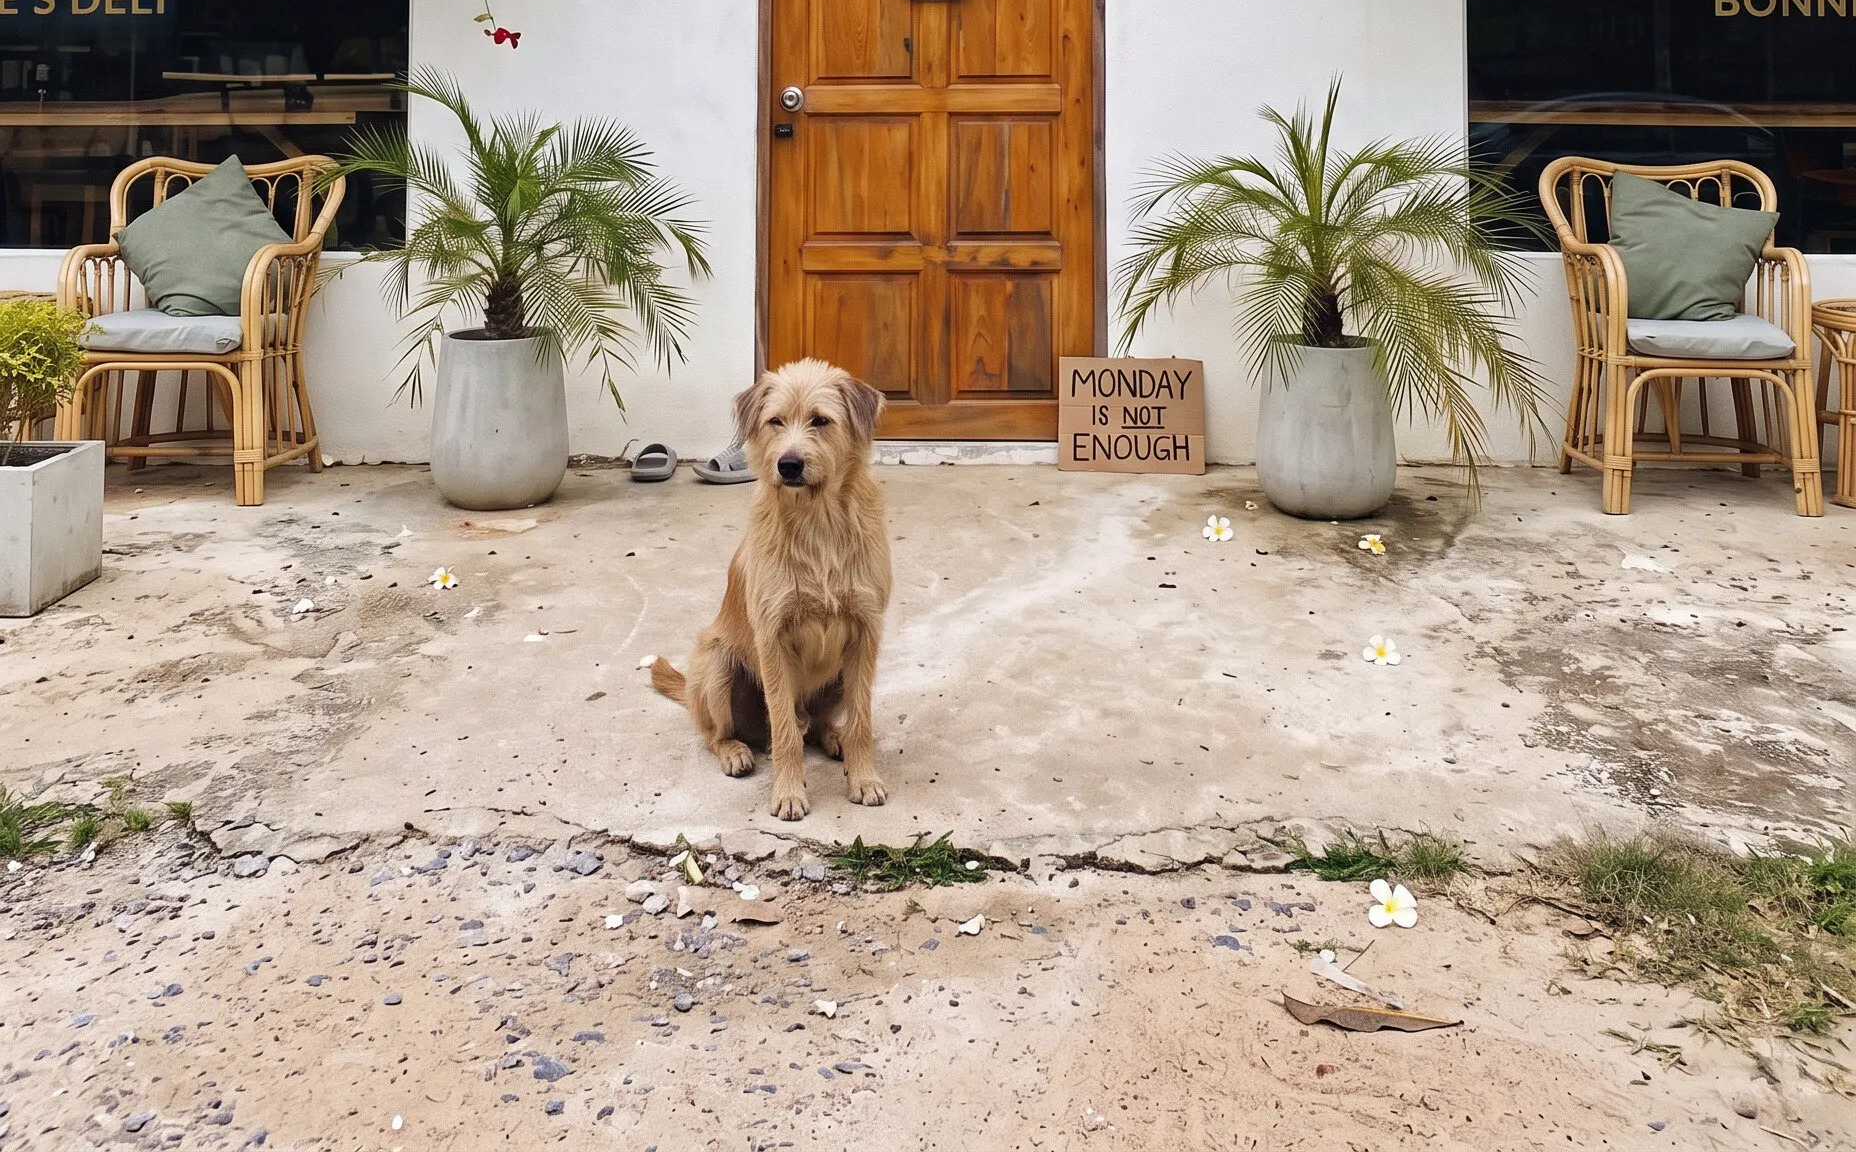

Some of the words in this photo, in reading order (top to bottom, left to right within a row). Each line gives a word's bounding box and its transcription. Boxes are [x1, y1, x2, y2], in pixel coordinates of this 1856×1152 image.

[1071, 368, 1193, 400] MONDAY
[1092, 404, 1109, 426] IS
[1121, 405, 1167, 426] NOT
[1073, 432, 1190, 462] ENOUGH
